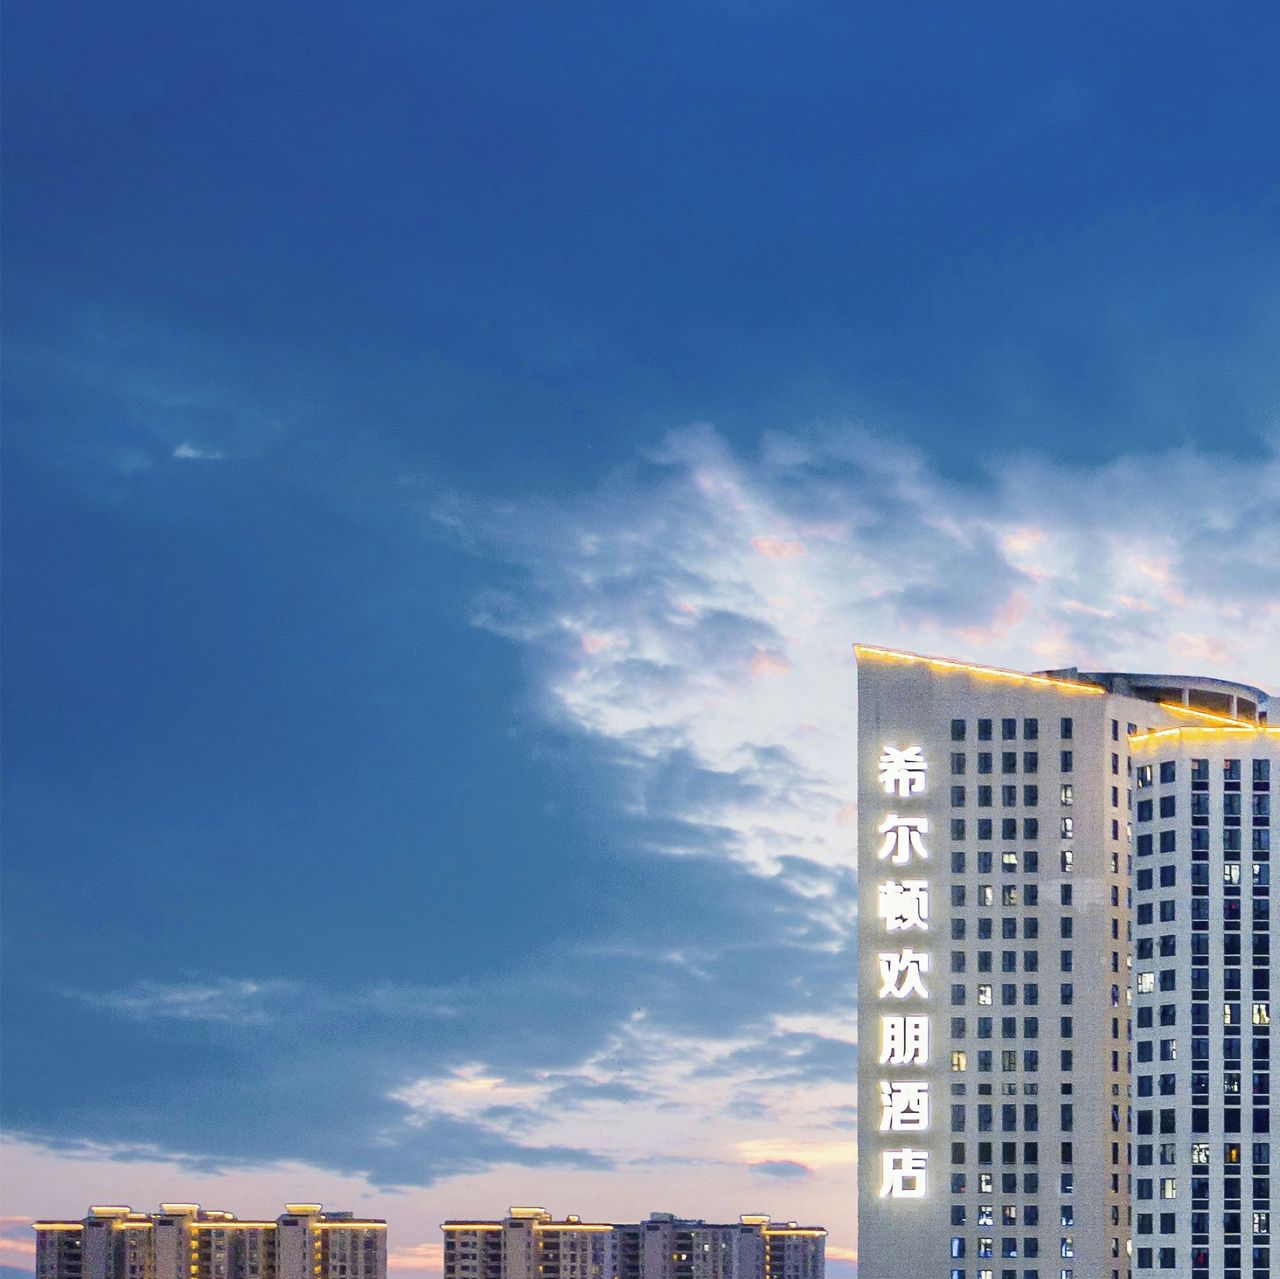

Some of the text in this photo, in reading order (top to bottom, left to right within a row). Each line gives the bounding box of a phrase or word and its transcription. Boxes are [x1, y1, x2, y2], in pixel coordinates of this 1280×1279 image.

[879, 745, 930, 1200] 希尔顿欢朋酒店
